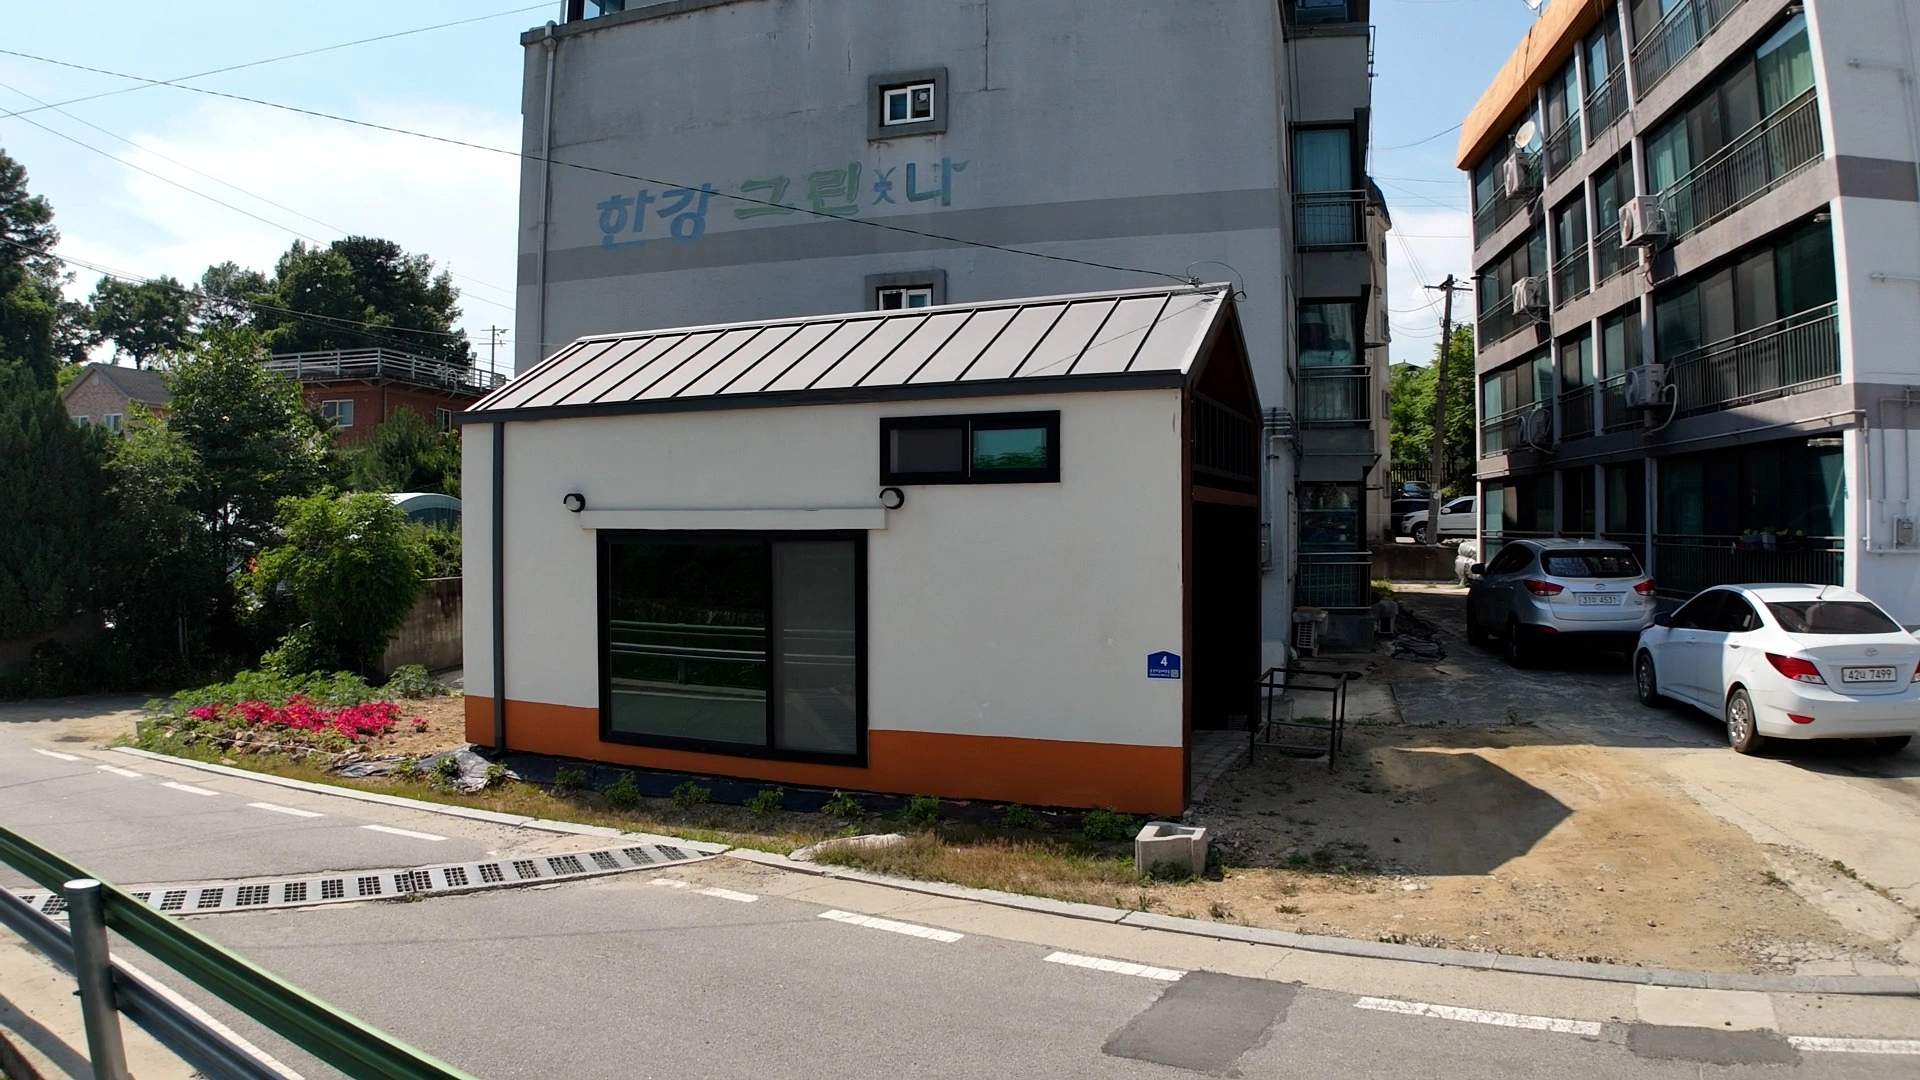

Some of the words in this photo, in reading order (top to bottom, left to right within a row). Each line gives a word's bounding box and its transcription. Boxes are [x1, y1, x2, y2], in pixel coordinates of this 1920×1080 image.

[596, 182, 720, 250] 한강
[733, 160, 863, 218] 그린
[1160, 655, 1168, 667] 4
[1869, 669, 1892, 680] 7499
